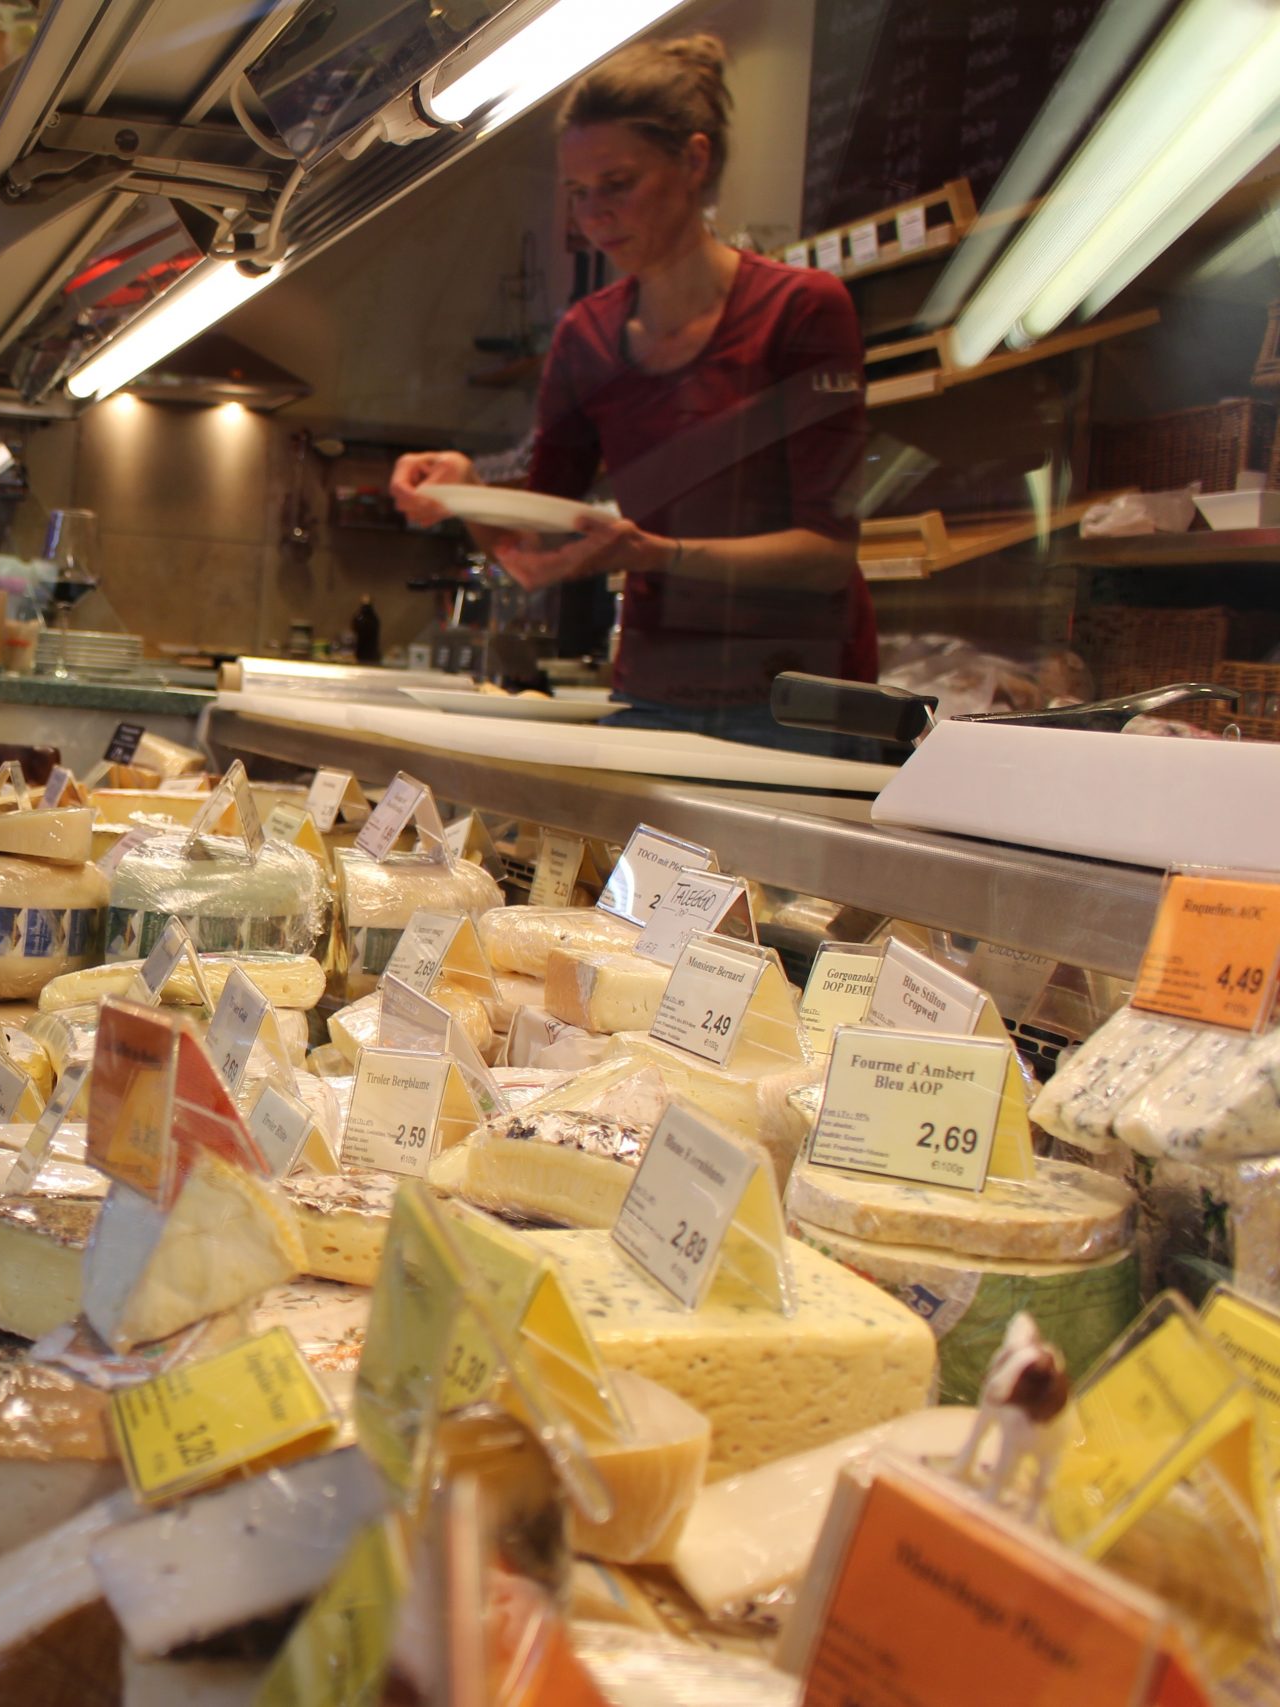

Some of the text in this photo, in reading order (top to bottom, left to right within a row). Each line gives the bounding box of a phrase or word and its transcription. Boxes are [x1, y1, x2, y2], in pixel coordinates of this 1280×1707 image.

[637, 848, 658, 863] TOCO
[658, 857, 670, 868] mit
[671, 882, 716, 912] TALEGGIO
[414, 960, 436, 977] 2,69
[686, 955, 746, 983] Monsieur Bernard
[826, 967, 874, 983] Gorgonzola
[1217, 963, 1265, 996] 4,49
[822, 980, 843, 993] DOP
[902, 975, 947, 1012] Blue Stilton
[902, 992, 939, 1024] Cropwell
[700, 1009, 732, 1036] 2,49
[850, 1054, 903, 1074] Fourme
[367, 1072, 430, 1091] Tiroler Bergblume
[874, 1075, 944, 1096] Bleu AOP
[394, 1123, 427, 1149] 2,59
[916, 1122, 978, 1155] 2,69
[670, 1220, 709, 1265] 2,89
[175, 1423, 218, 1468] 3,29
